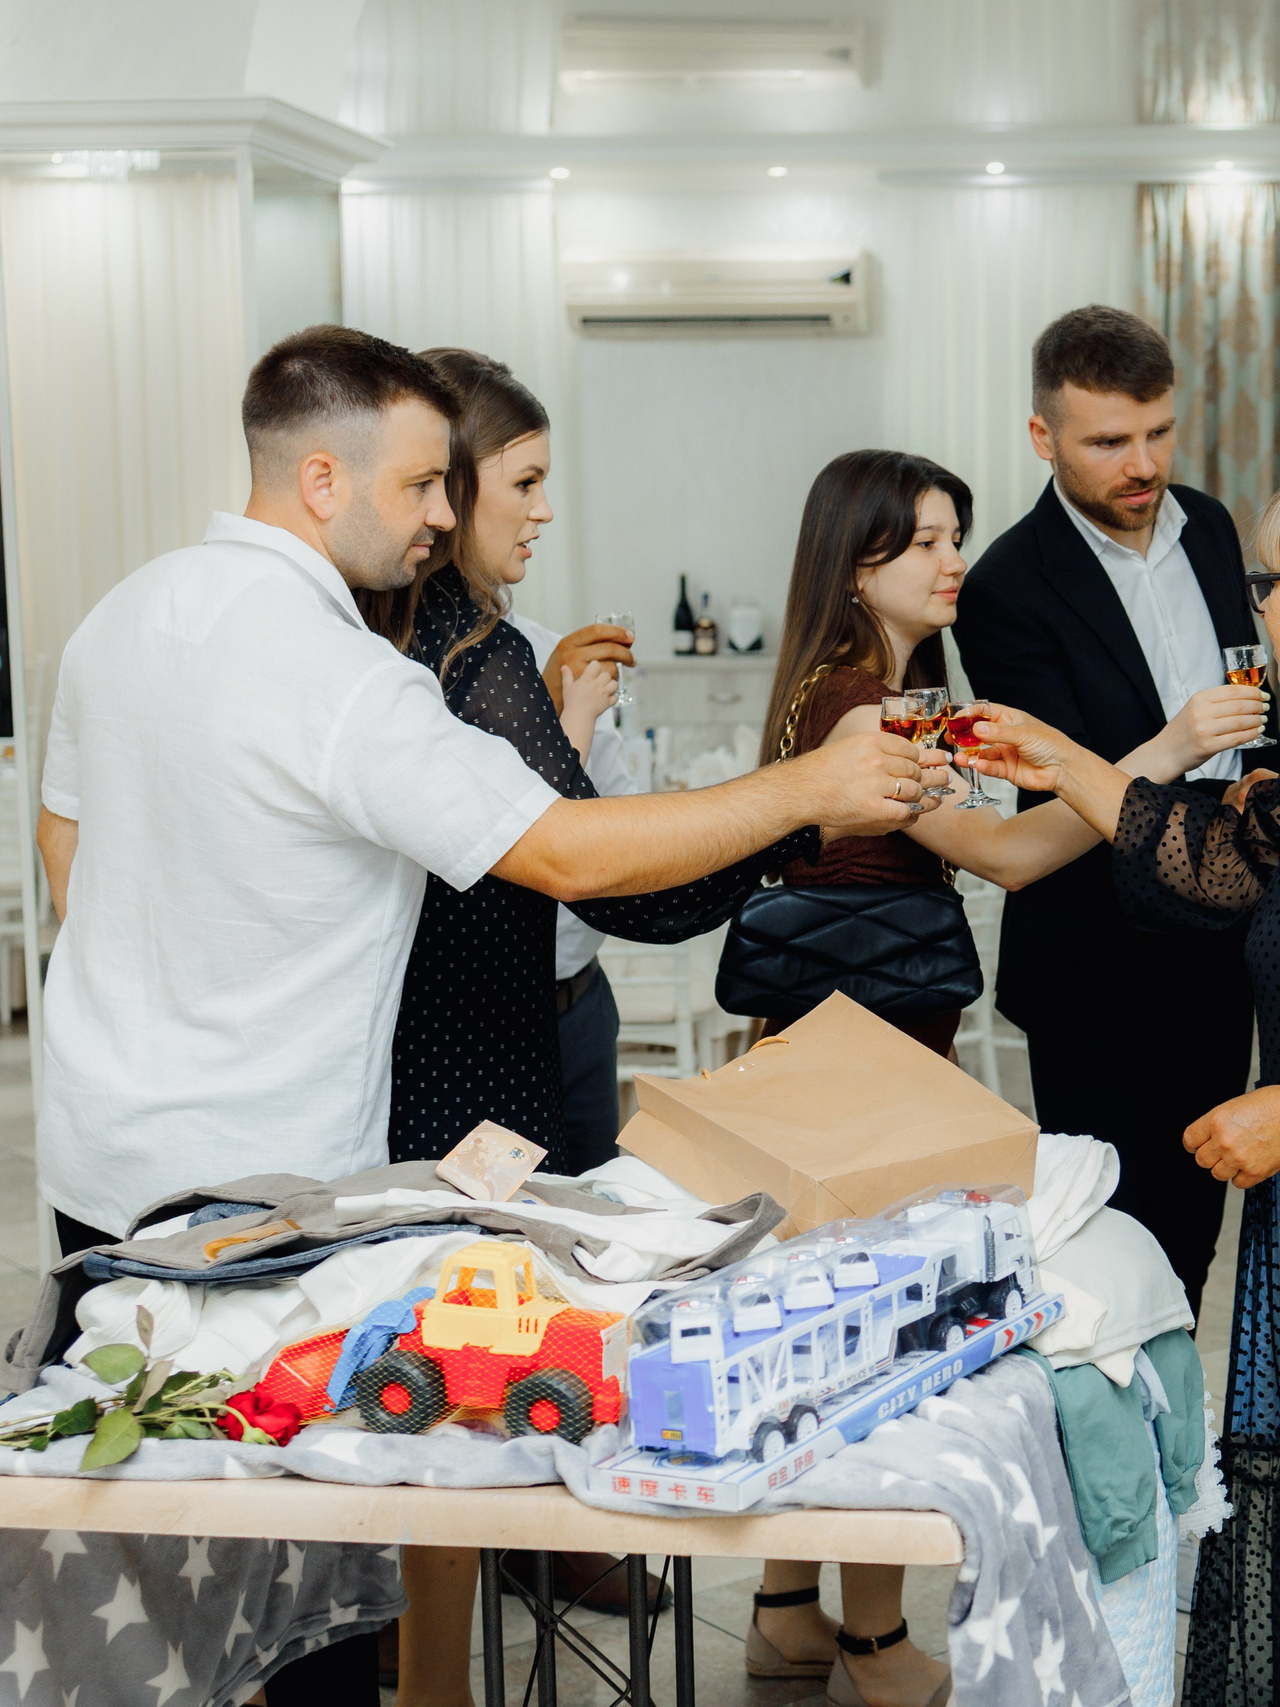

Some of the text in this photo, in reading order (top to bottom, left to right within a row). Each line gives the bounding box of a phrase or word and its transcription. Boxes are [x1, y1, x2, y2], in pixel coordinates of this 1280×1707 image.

[847, 1368, 867, 1385] POLICE
[878, 1359, 963, 1419] CITY HERO
[612, 1476, 715, 1504] 速度卡车
